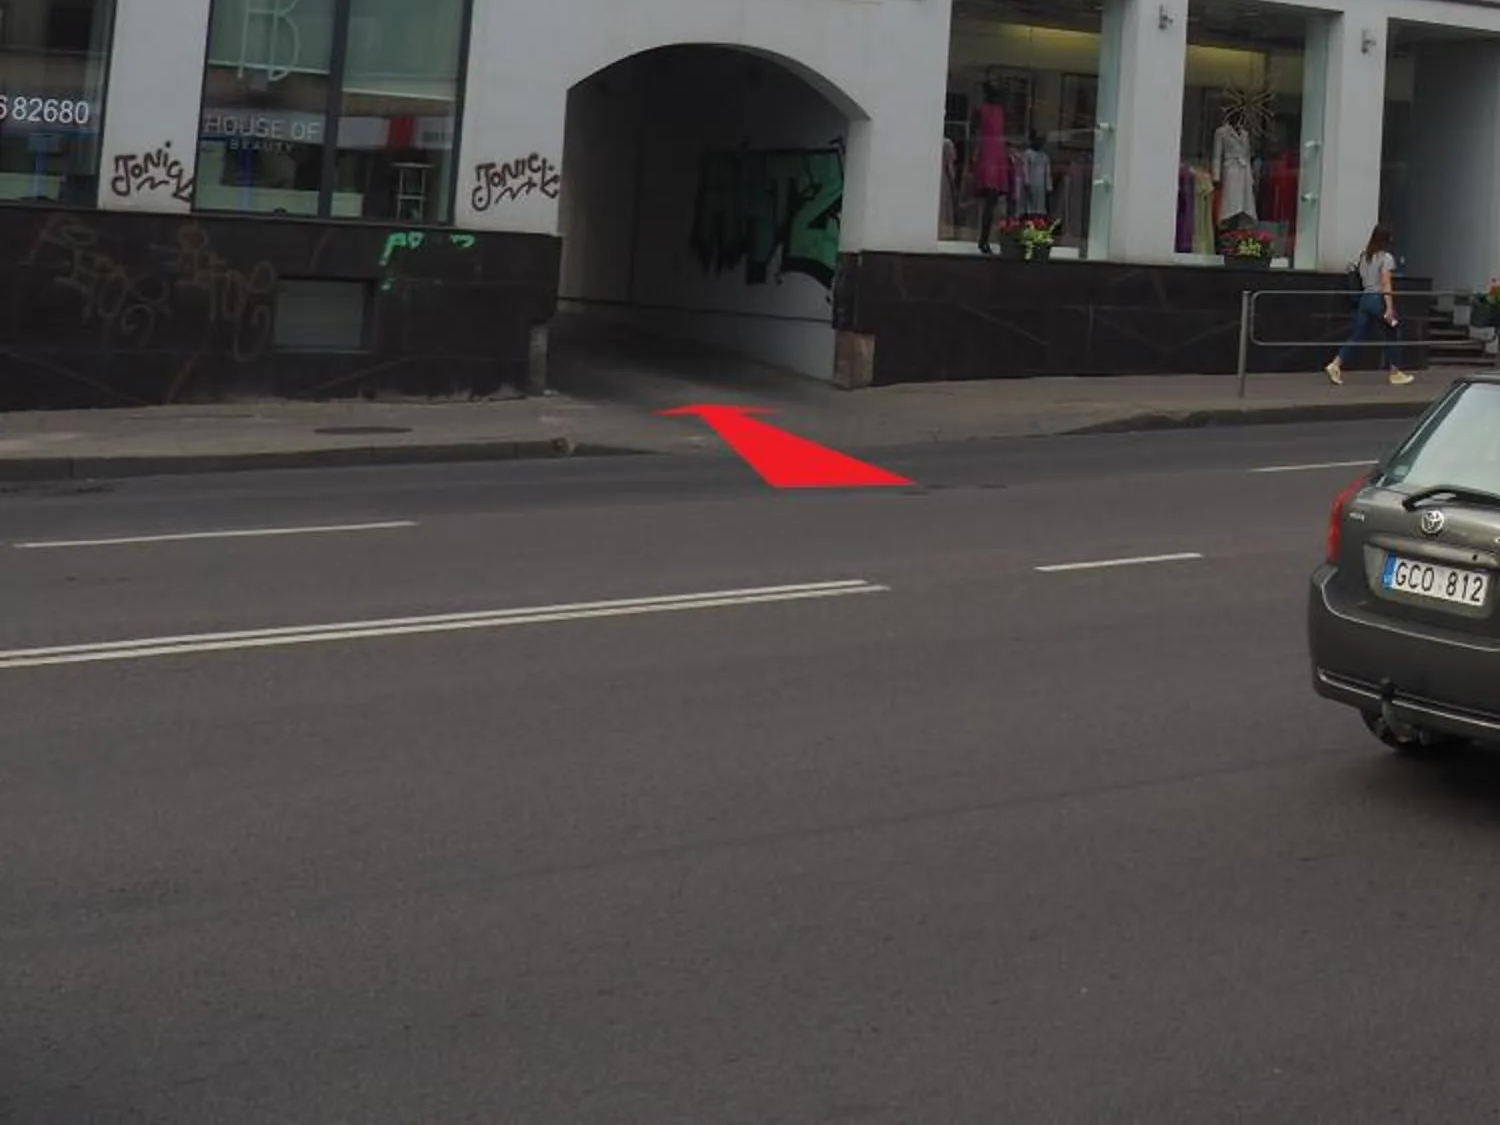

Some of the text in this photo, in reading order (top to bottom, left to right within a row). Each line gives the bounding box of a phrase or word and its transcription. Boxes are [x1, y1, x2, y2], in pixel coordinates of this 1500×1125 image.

[204, 114, 321, 141] HOUSE OF
[1395, 562, 1484, 603] GCO 812
